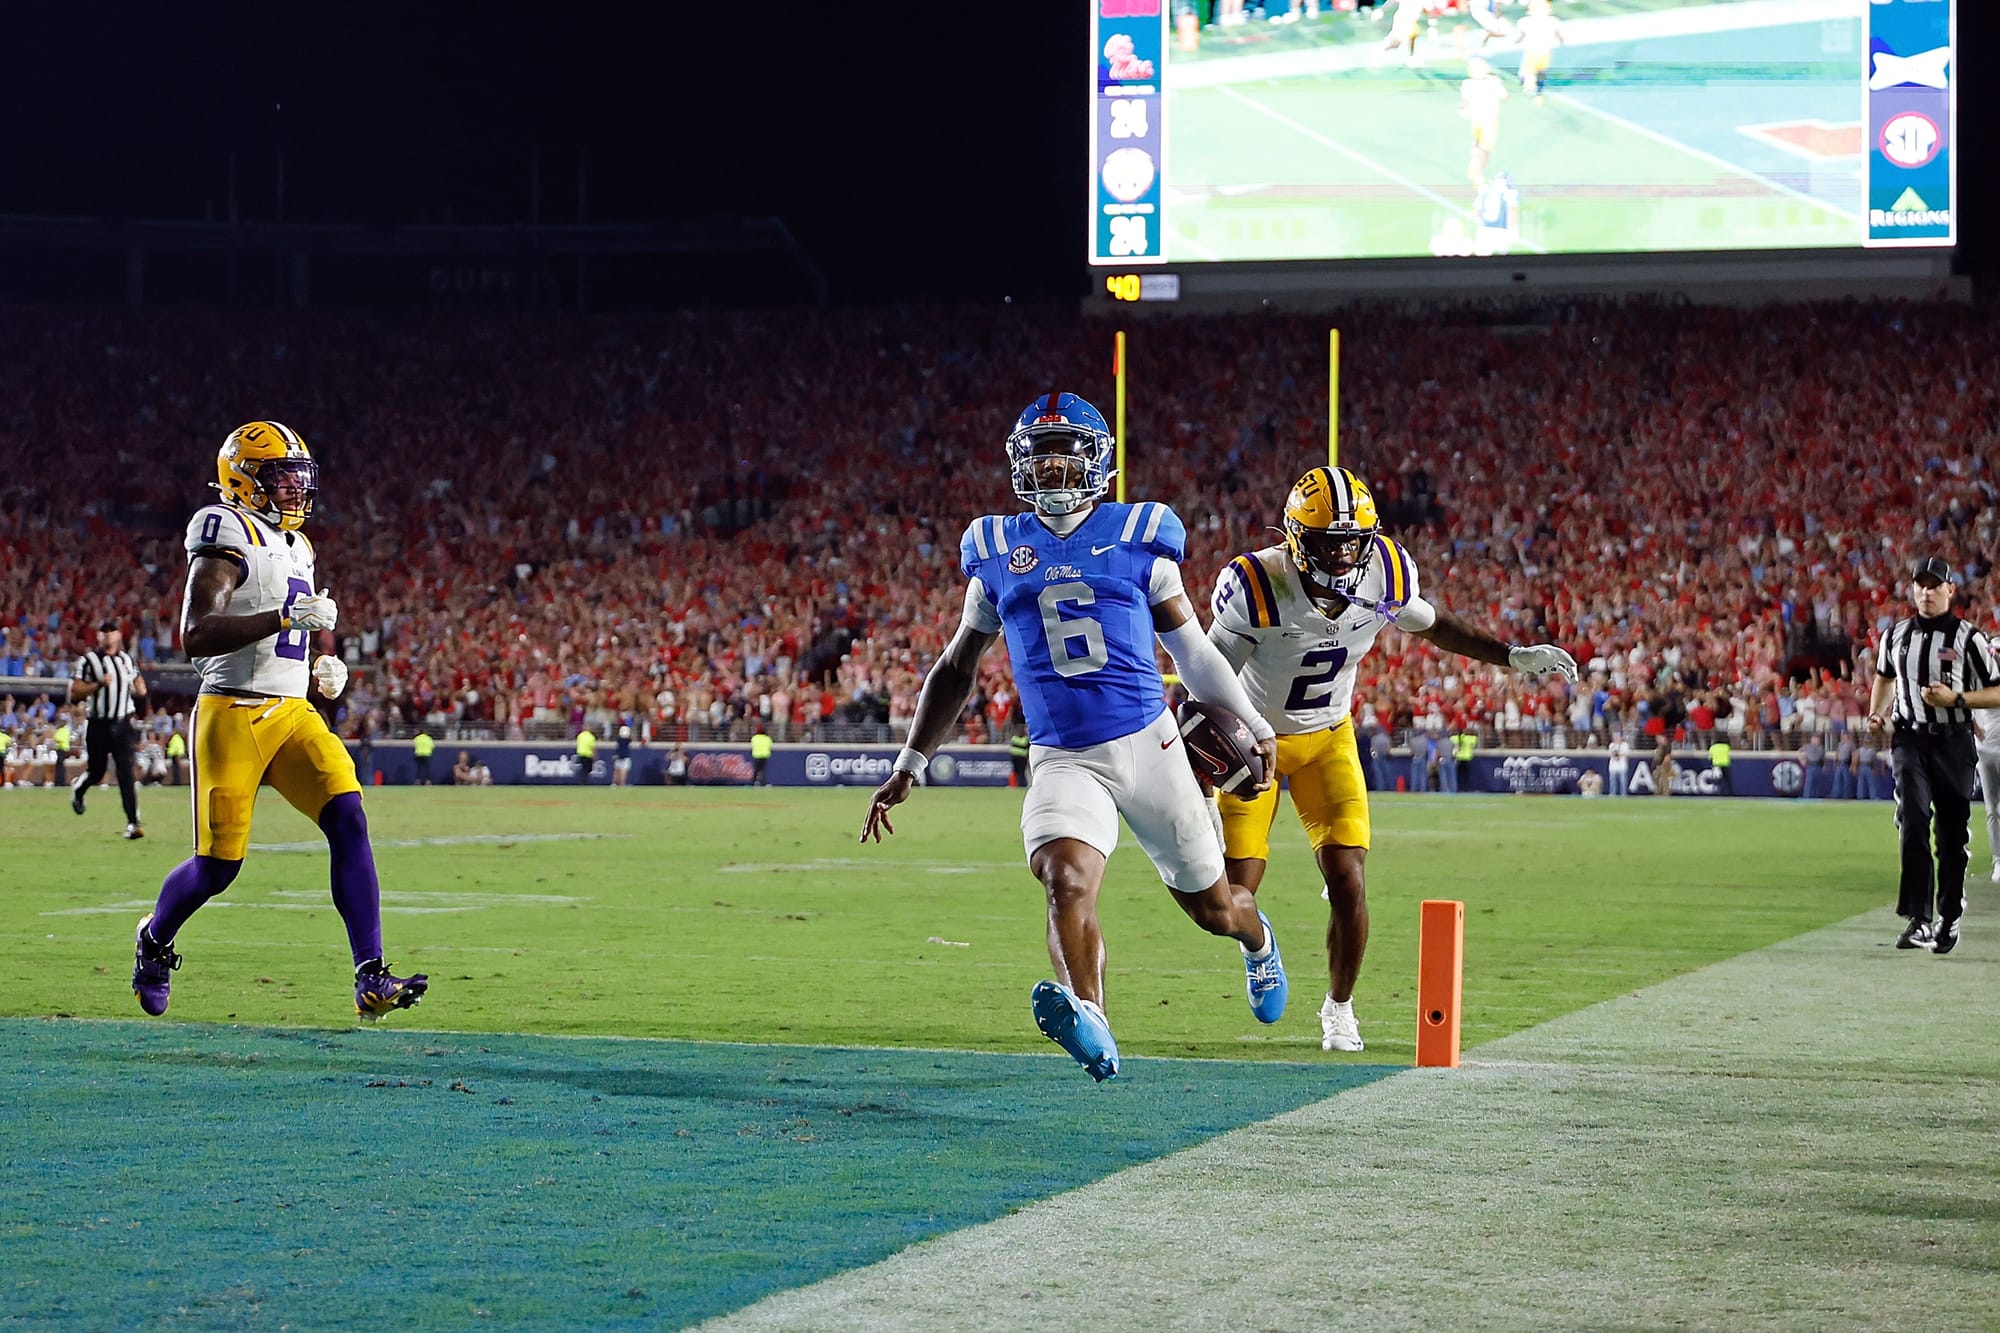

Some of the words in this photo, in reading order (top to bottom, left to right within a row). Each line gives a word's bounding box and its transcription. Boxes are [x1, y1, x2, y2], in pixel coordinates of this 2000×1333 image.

[1106, 274, 1140, 301] 40
[203, 513, 222, 543] 0
[1012, 546, 1033, 567] SEC
[1045, 566, 1060, 580] Ole
[1059, 565, 1082, 578] Miss
[1216, 581, 1234, 614] 2
[1038, 582, 1108, 678] 6
[1319, 640, 1338, 648] LSU
[1285, 647, 1347, 710] 2
[1494, 767, 1536, 779] PEARL
[1540, 767, 1579, 778] RIVER
